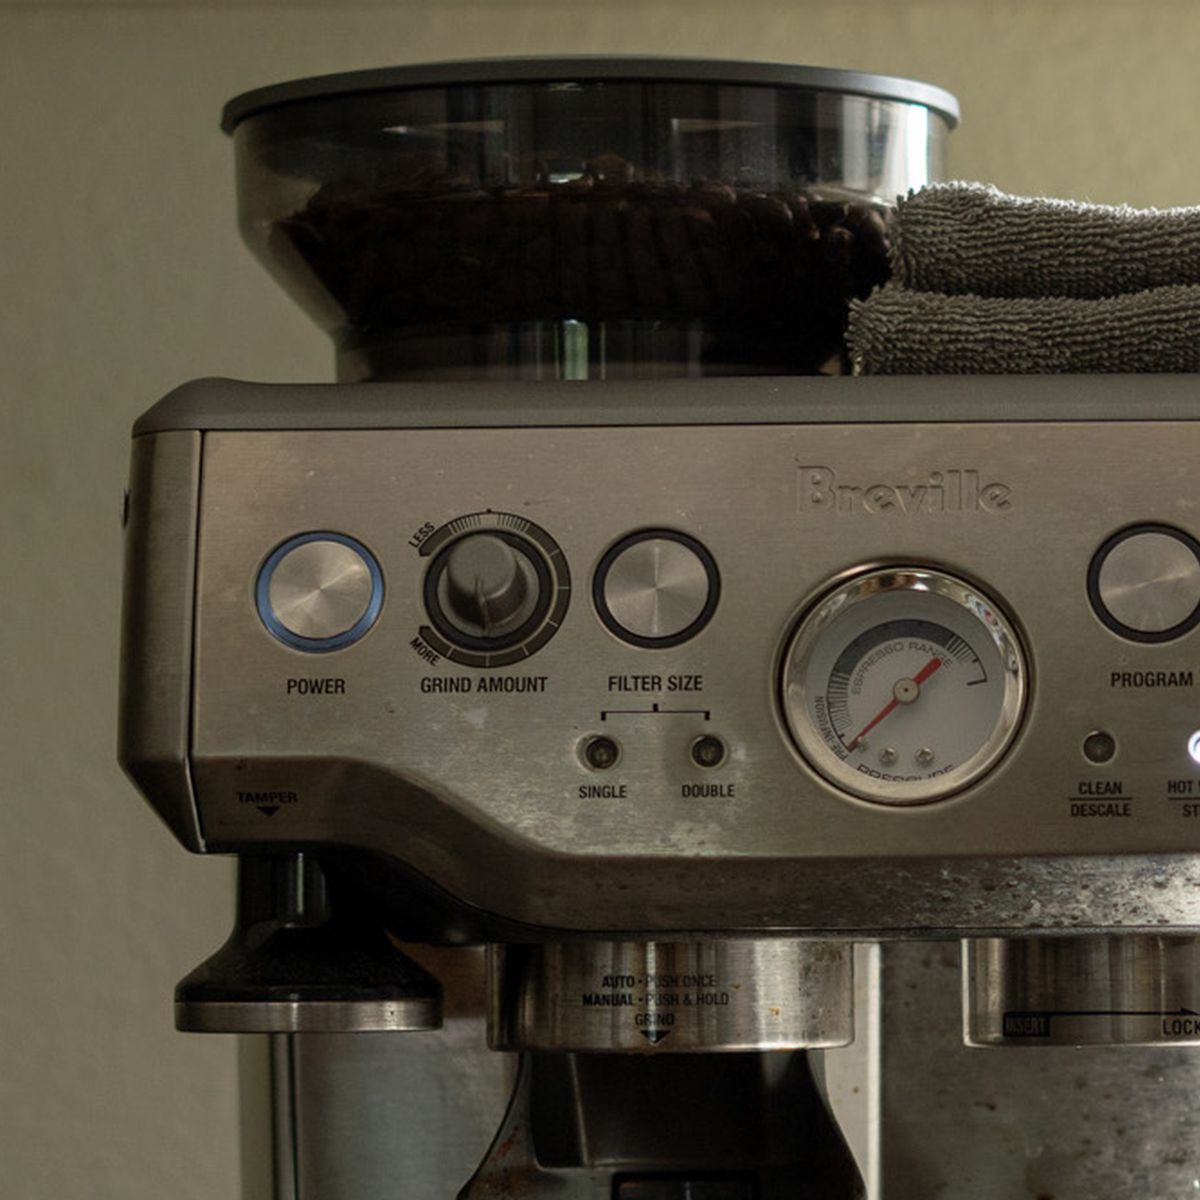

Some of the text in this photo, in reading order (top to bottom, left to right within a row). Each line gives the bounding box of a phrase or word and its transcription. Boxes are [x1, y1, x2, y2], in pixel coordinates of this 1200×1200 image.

[797, 464, 1014, 514] Breville
[408, 521, 437, 549] LESS
[408, 636, 441, 667] MORE
[286, 678, 346, 695] POWER
[420, 676, 549, 694] GRIND AMOUNT
[607, 674, 704, 692] FILTER SIZE
[1111, 671, 1194, 688] PROGRAM
[578, 783, 735, 799] SINGLE DOUBLE
[1078, 781, 1123, 796] CLEAN
[1167, 780, 1195, 794] HOT
[237, 790, 299, 804] TAMPER
[1070, 802, 1132, 818] DESCALE
[602, 975, 635, 988] AUTO
[682, 974, 717, 988] ONCE
[581, 992, 634, 1006] MANUAL
[683, 993, 694, 1006] &
[697, 992, 729, 1006] HOLD
